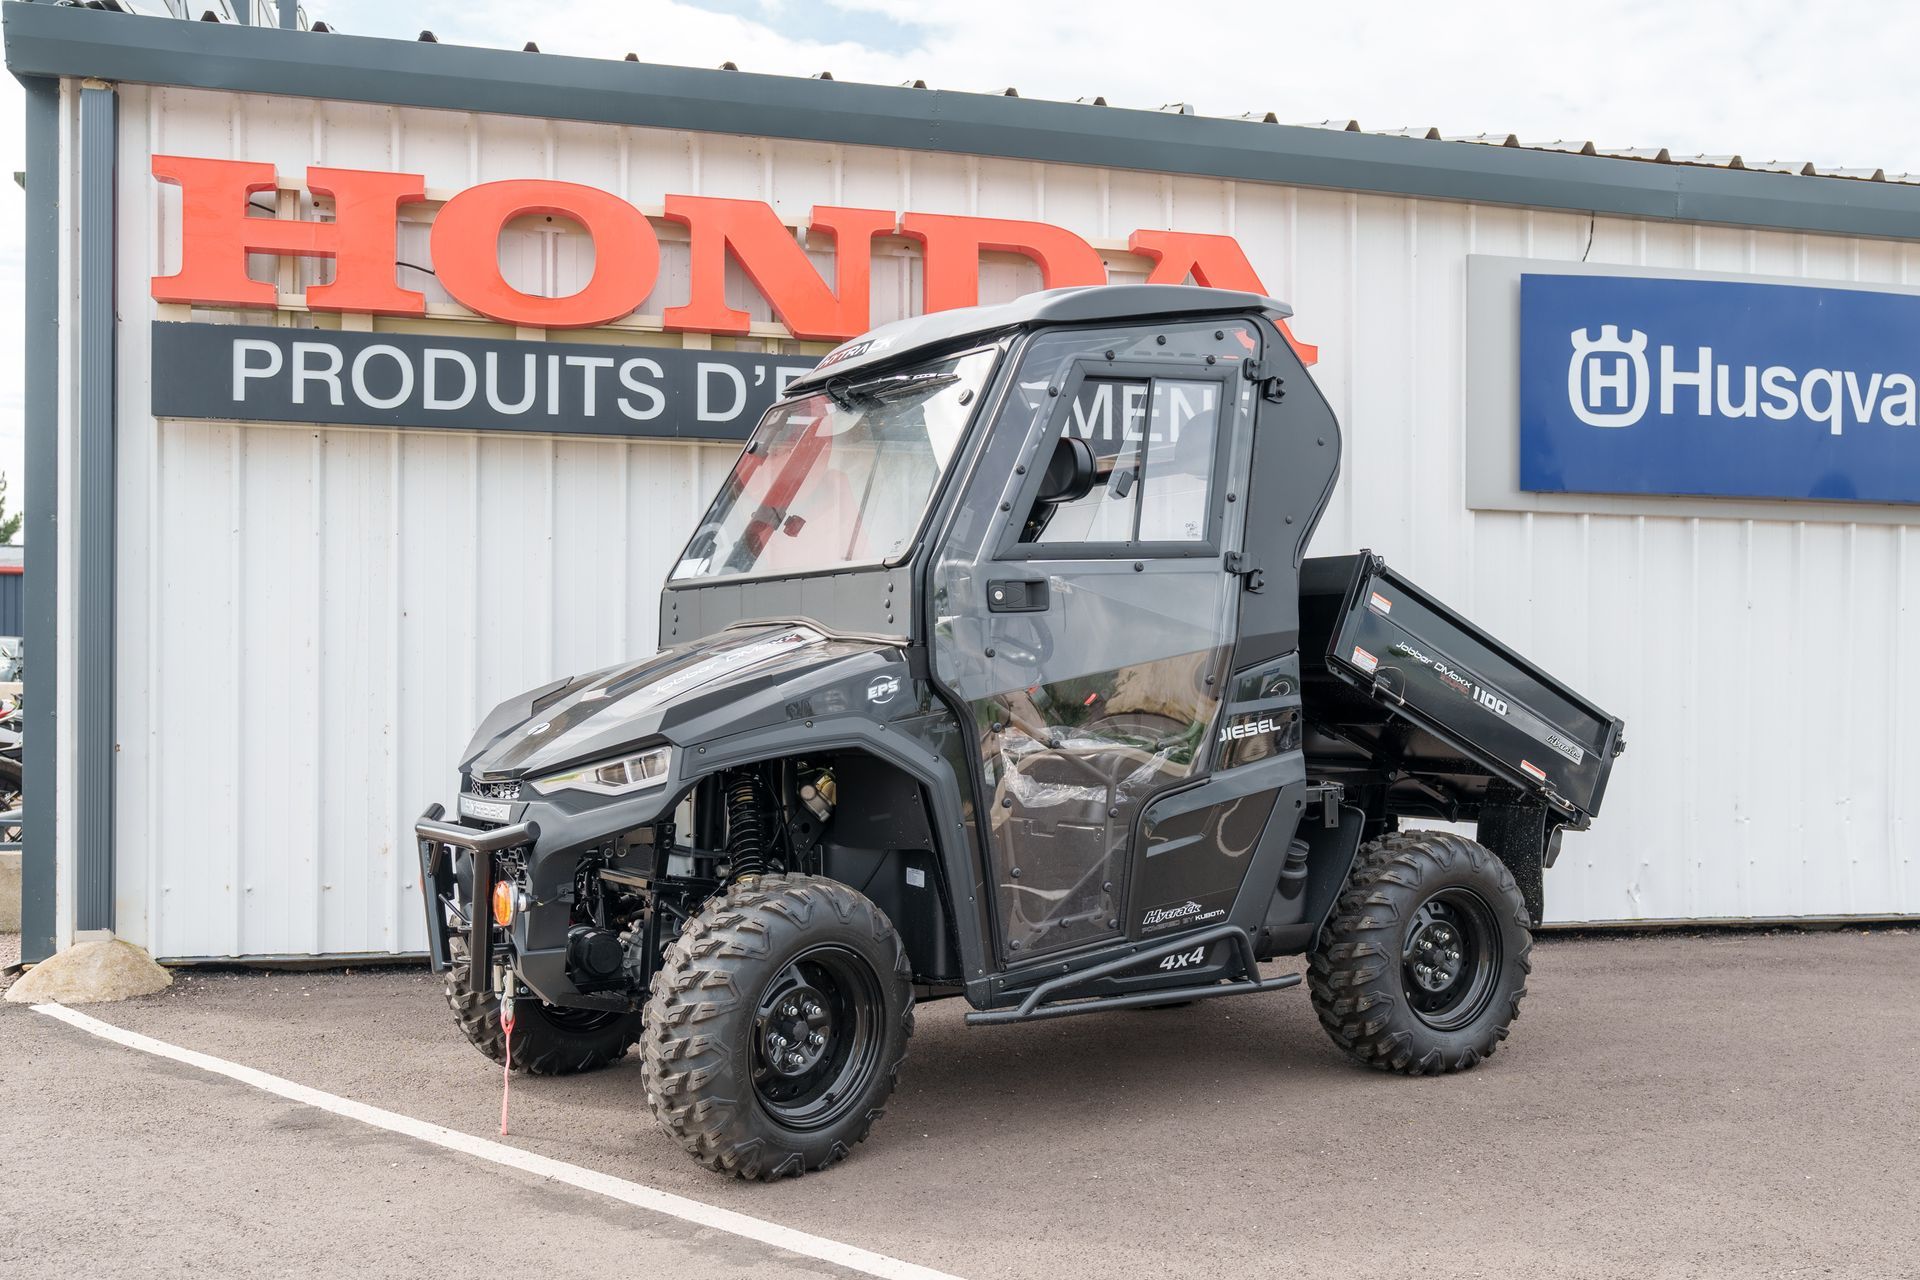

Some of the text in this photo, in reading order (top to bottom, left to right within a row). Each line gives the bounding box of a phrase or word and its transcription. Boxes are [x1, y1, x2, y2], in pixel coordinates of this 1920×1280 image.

[232, 339, 666, 421] PRODUITS
[1589, 358, 1628, 408] H
[867, 678, 900, 700] EPS
[1472, 685, 1508, 716] 1100
[1195, 909, 1225, 921] KUBOTA
[1159, 946, 1205, 970] 4x4
